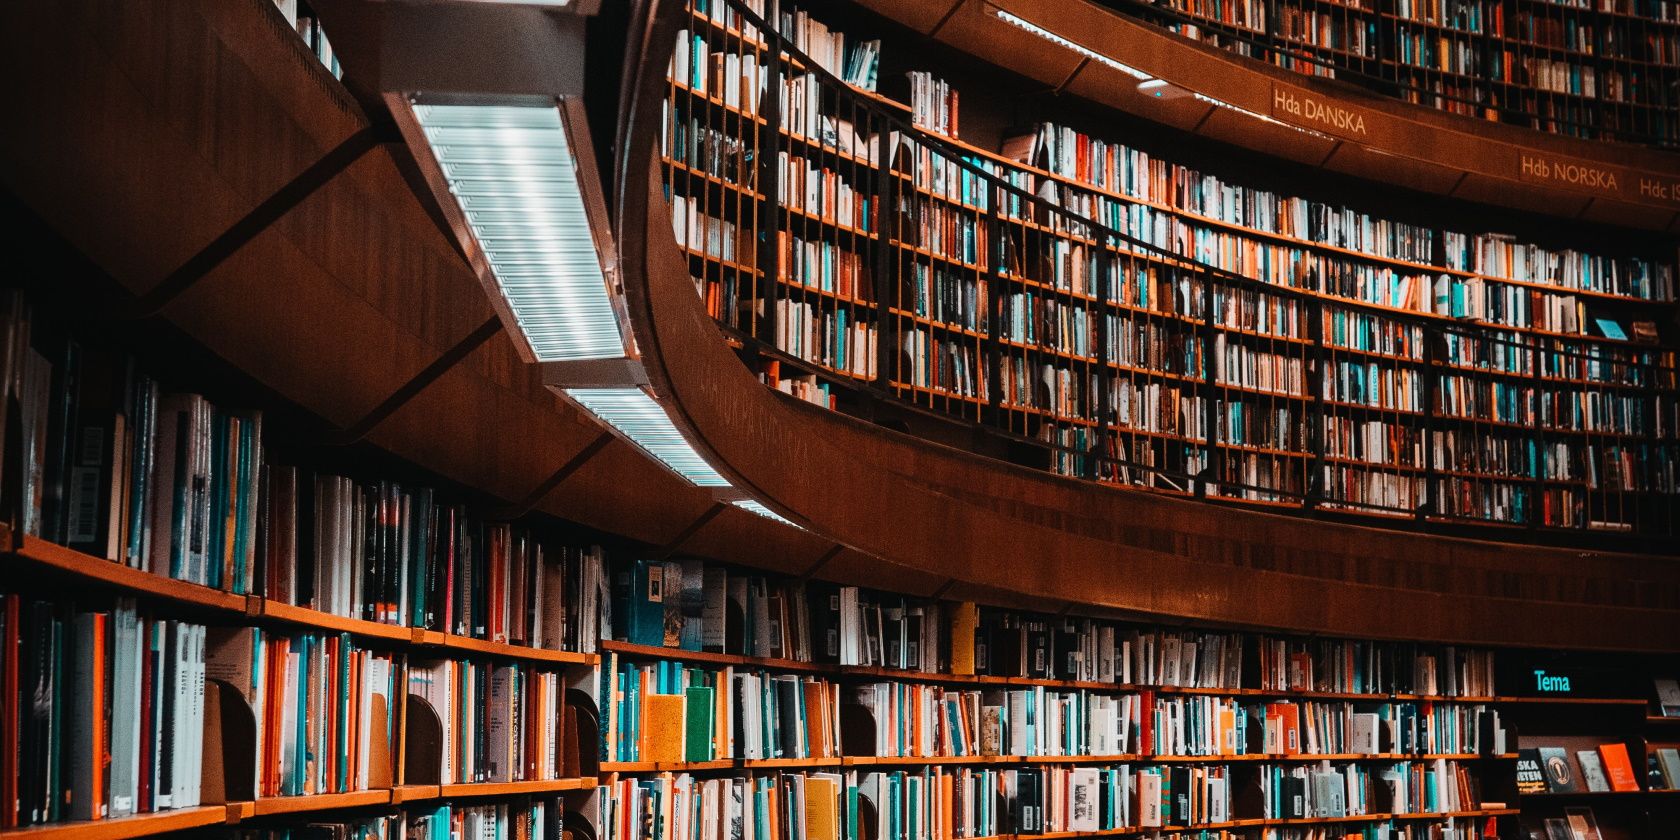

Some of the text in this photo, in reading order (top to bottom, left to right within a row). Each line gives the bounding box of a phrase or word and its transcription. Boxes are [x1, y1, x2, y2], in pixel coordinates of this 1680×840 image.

[1274, 89, 1366, 135] Hda DANSKA
[1521, 156, 1617, 190] Hdb NORSKA
[1639, 178, 1668, 200] Hdc
[1534, 669, 1571, 692] Tema
